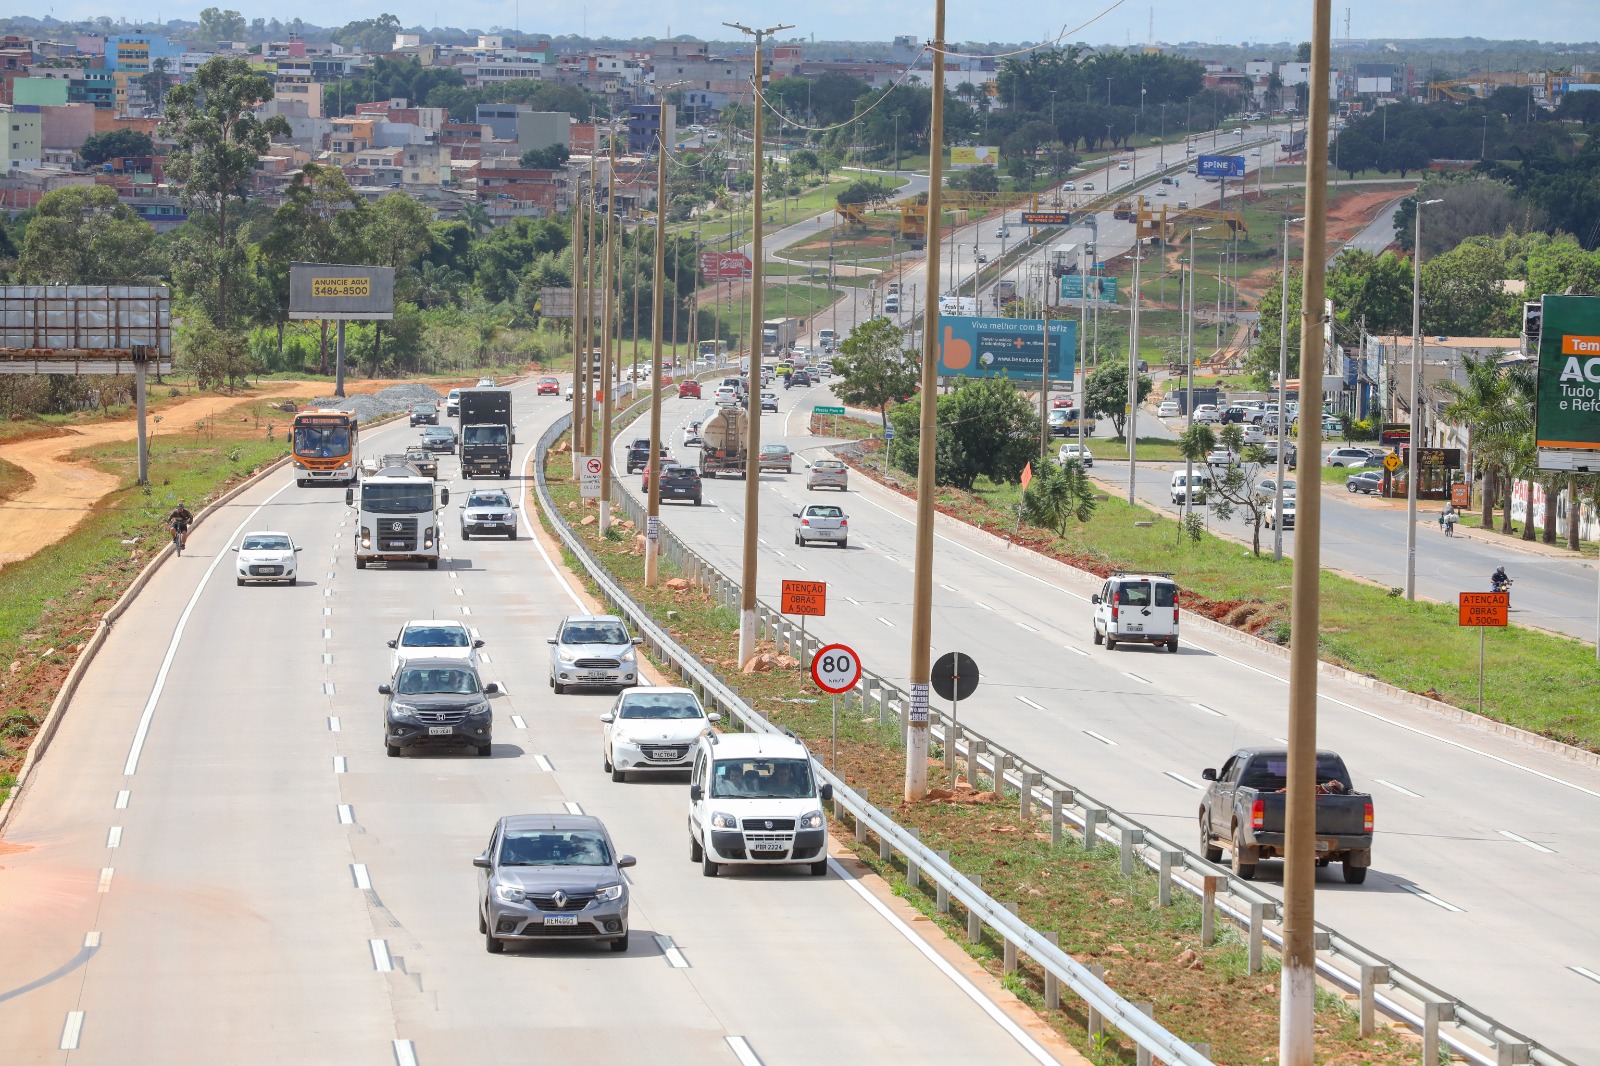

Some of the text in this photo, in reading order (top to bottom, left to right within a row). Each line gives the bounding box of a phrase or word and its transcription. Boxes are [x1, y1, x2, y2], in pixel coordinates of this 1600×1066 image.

[314, 287, 368, 295] 3486-8500
[990, 322, 1017, 330] melhor
[1572, 339, 1600, 351] Tem
[1560, 384, 1594, 398] Tudo
[1560, 401, 1568, 410] e
[785, 584, 823, 594] ATENÇÃO
[790, 596, 816, 604] OBRAS
[1463, 595, 1504, 605] ATENÇÃO
[822, 656, 850, 673] 80
